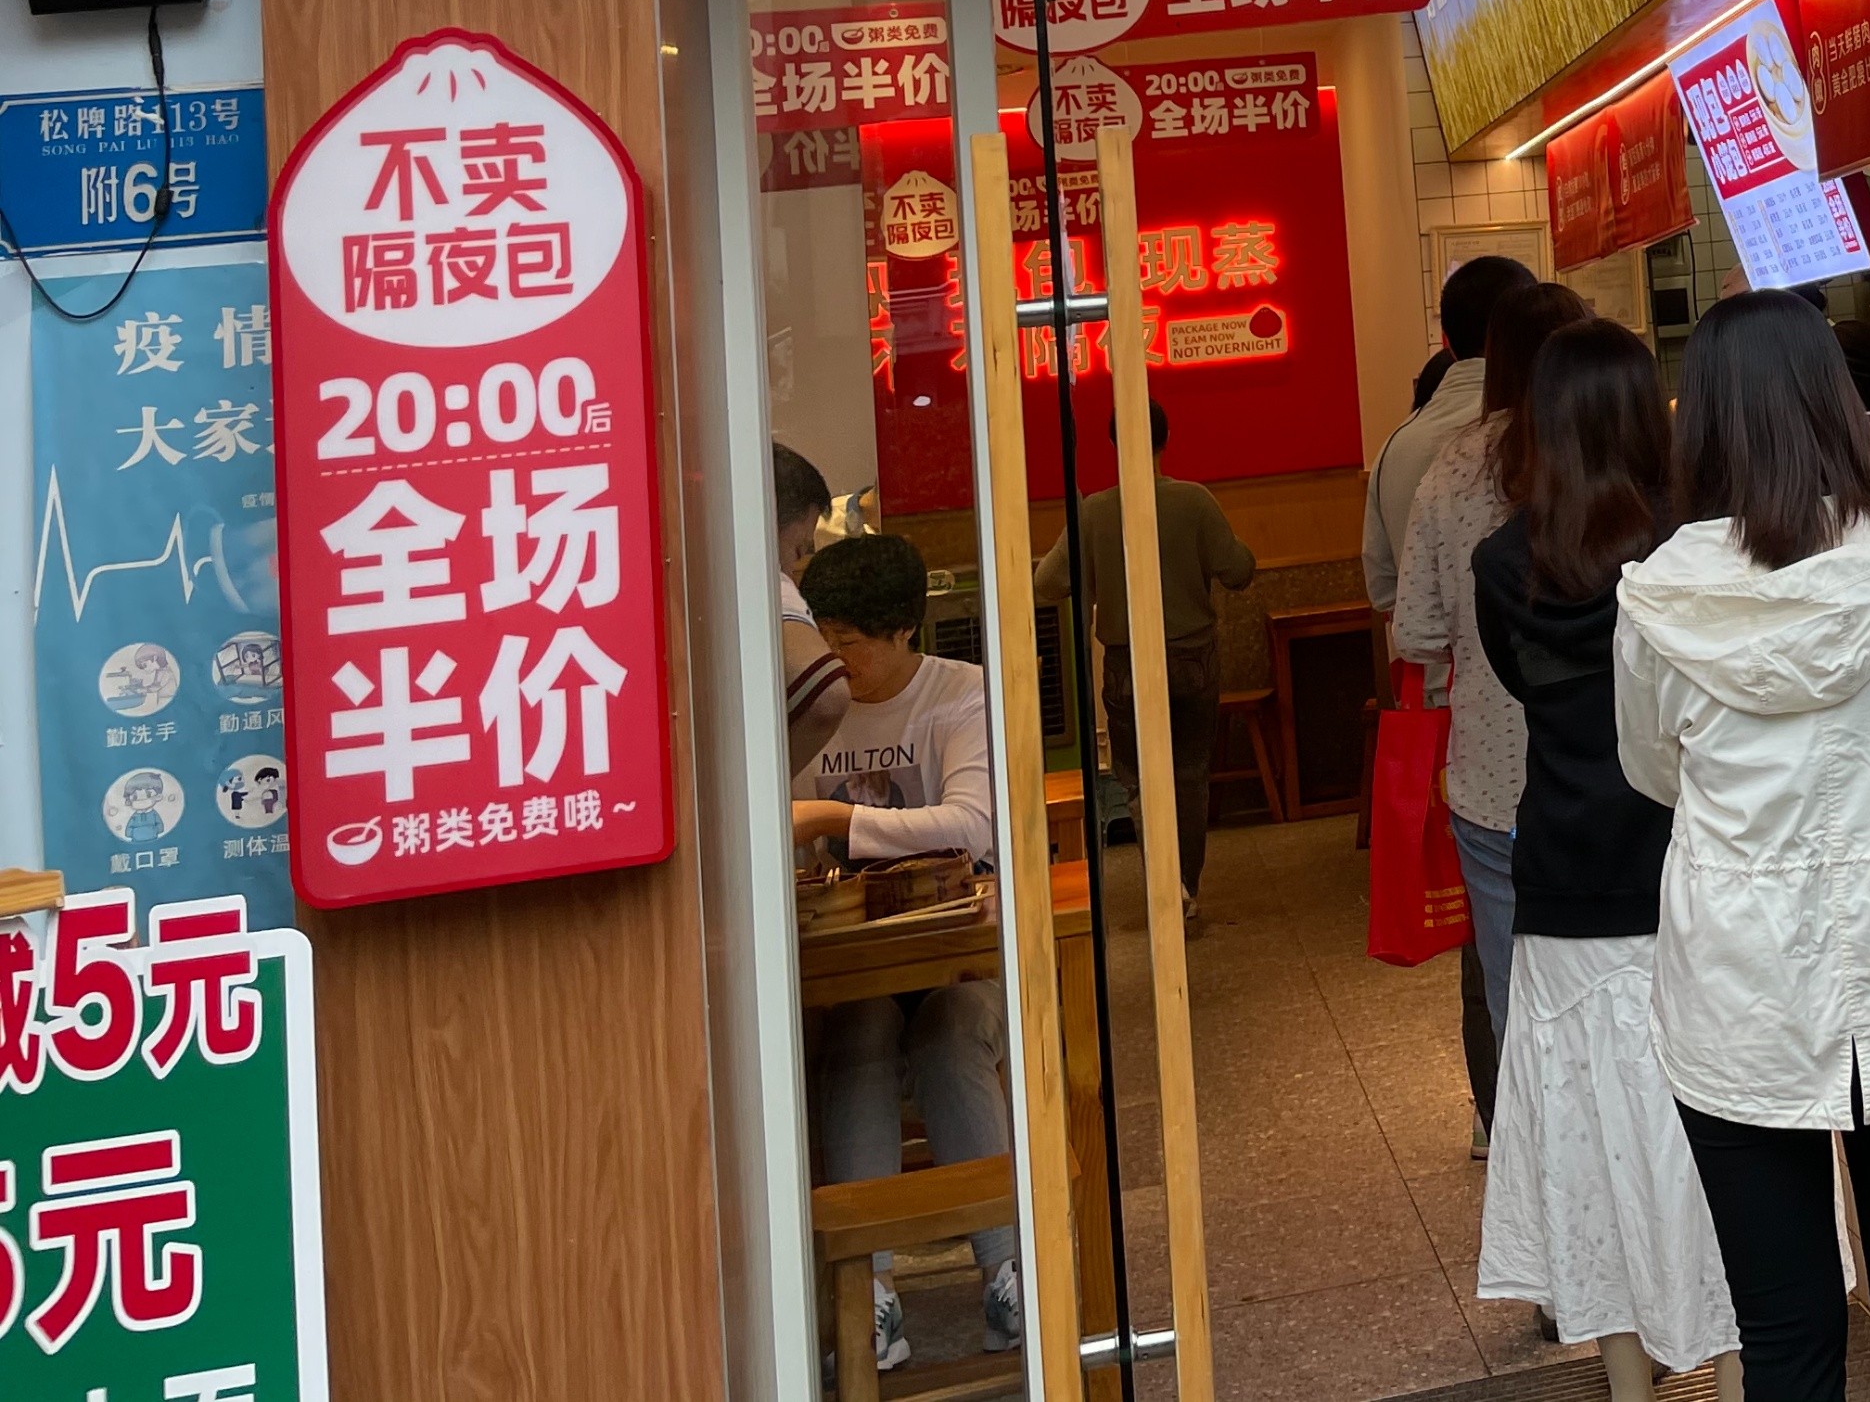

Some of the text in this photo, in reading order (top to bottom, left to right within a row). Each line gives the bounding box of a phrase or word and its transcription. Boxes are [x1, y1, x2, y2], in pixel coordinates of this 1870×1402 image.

[868, 22, 939, 44] 粥类免费
[1054, 82, 1117, 116] 不卖
[1149, 90, 1311, 139] 全场半价
[41, 144, 86, 156] SONG
[98, 141, 125, 153] PAI
[205, 133, 239, 146] HAO
[360, 123, 548, 222] 不卖
[81, 161, 200, 225] 附6号
[890, 191, 946, 220] 不卖
[887, 218, 955, 246] 隔夜包
[342, 222, 574, 313] 隔夜包
[113, 304, 273, 376] 疫情
[1172, 320, 1247, 335] PACKAGE NOW
[1210, 331, 1235, 342] NOW
[1173, 338, 1283, 359] NOT OVERNIGHT
[115, 399, 276, 471] 大家
[320, 462, 622, 636] 全场
[218, 708, 285, 735] 勤通风
[324, 625, 628, 804] 半价
[106, 721, 177, 748] 勤洗手
[821, 742, 915, 775] MILTON
[110, 846, 181, 874] 戴口罩
[223, 833, 291, 860] 测体温
